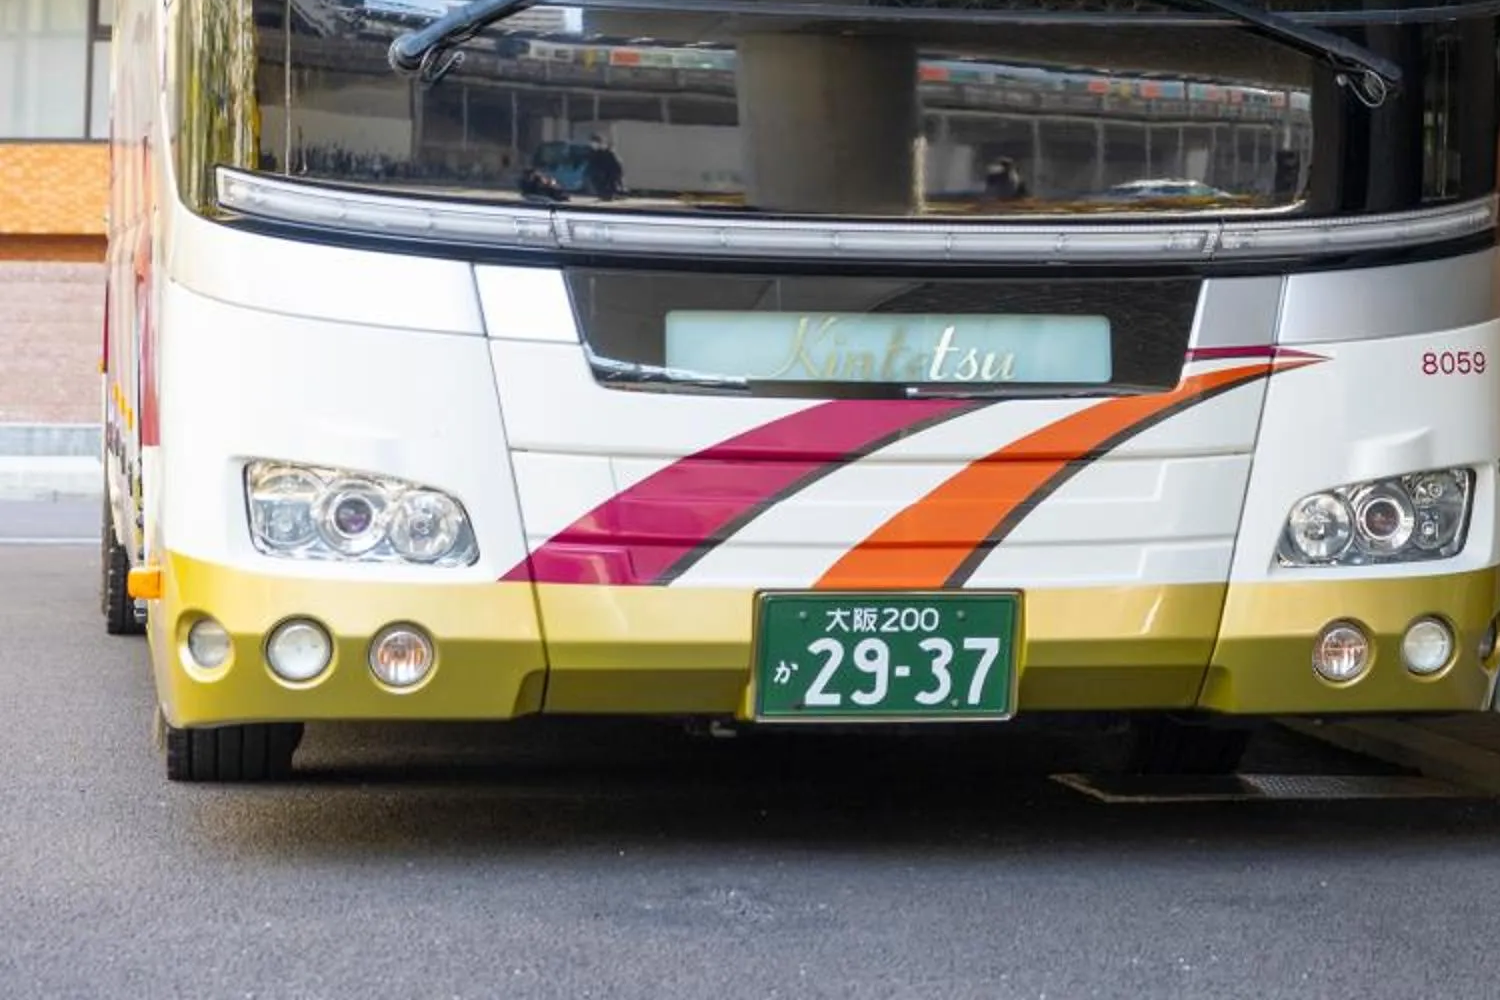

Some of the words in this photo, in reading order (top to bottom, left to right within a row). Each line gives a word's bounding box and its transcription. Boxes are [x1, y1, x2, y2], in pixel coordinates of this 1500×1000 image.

[758, 316, 1016, 381] Kintetsu
[1422, 351, 1486, 374] 8059
[773, 660, 799, 685] か
[803, 637, 1000, 705] 29-37
